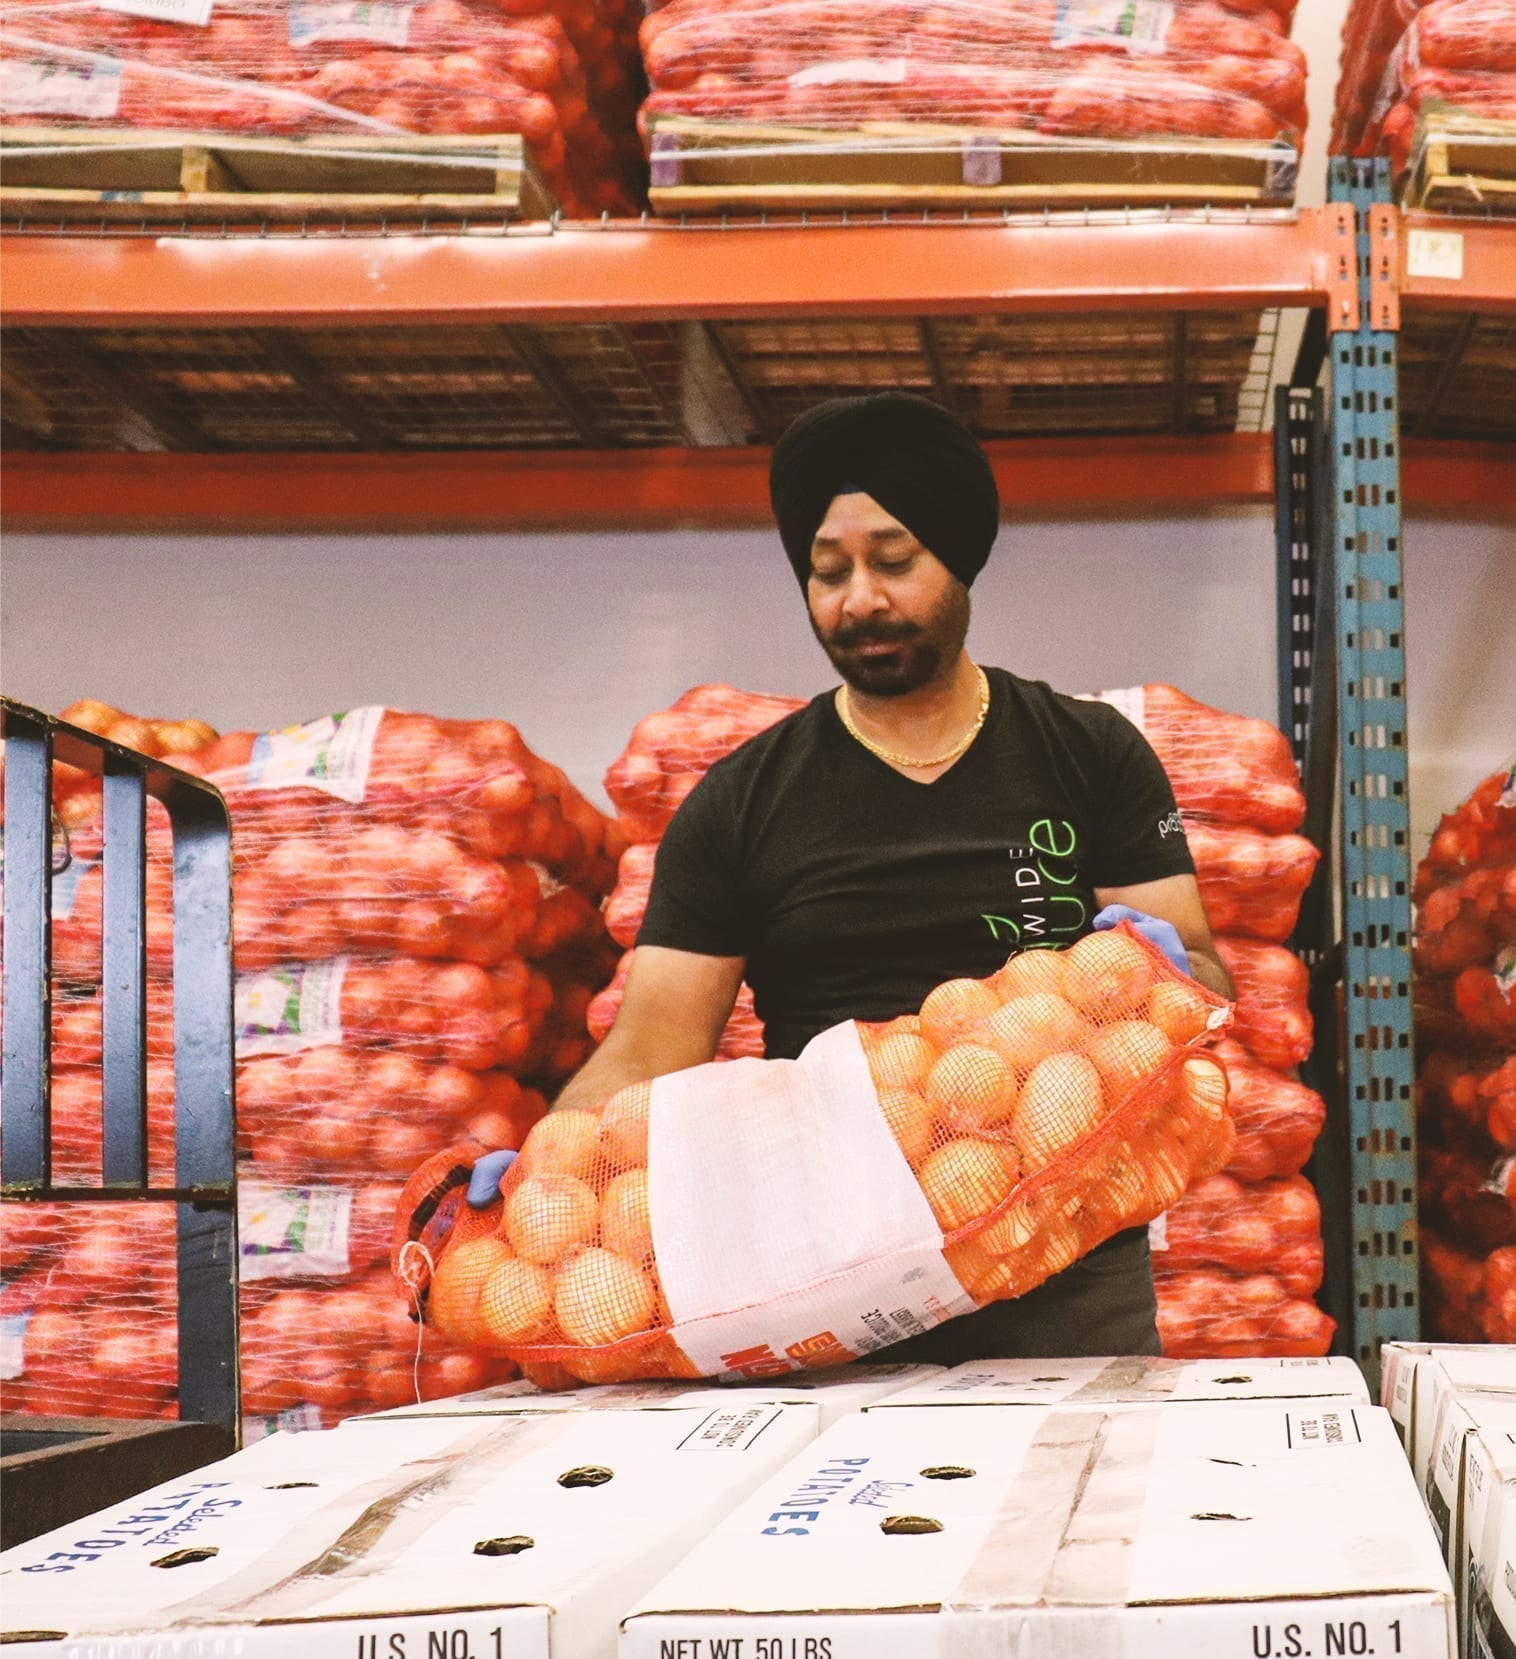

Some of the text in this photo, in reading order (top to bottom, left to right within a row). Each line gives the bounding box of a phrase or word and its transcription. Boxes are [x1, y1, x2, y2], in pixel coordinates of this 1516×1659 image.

[1009, 847, 1046, 939] WIDE
[20, 1482, 233, 1574] POTATOES
[142, 1498, 243, 1546] Selected
[760, 1457, 872, 1536] POTATOES
[489, 1626, 502, 1659] 1
[1252, 1619, 1401, 1658] U.S. NO. 1
